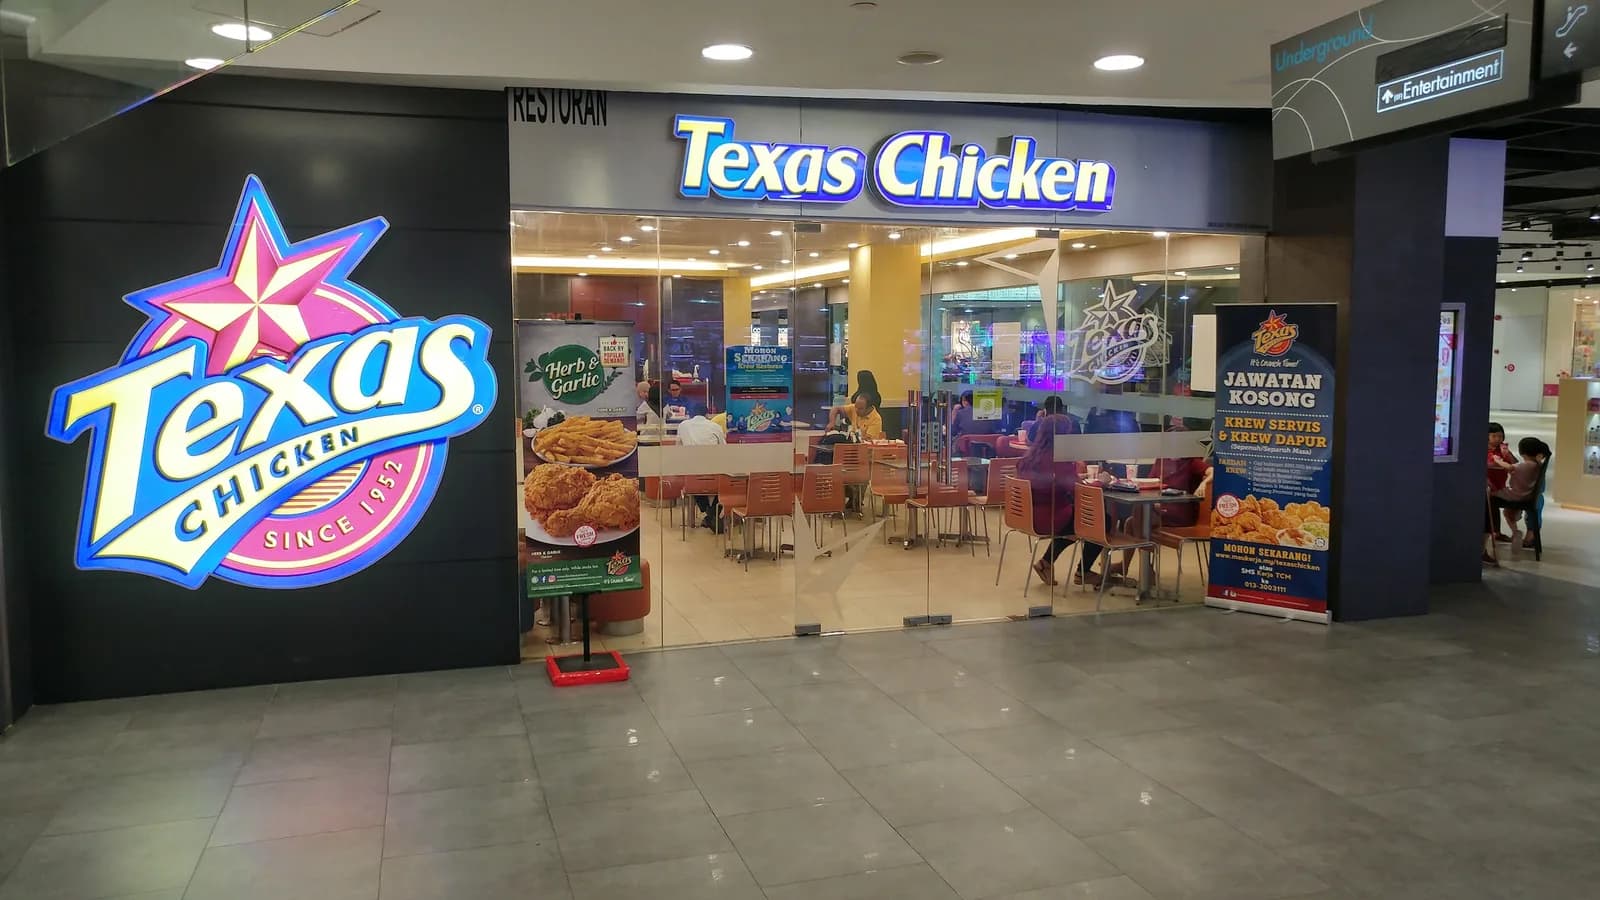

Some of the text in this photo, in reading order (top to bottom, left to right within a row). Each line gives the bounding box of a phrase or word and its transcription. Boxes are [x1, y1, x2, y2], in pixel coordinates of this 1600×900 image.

[1275, 15, 1374, 72] Underground
[1403, 59, 1499, 100] Entertainment
[513, 88, 607, 126] RESTORAN
[677, 119, 1110, 202] Texas Chicken
[1254, 325, 1297, 350] Texas
[545, 356, 600, 379] Herb &
[551, 372, 600, 399] Garlic
[1224, 372, 1322, 389] JAWATAN
[1229, 390, 1316, 408] KOSONG
[65, 324, 475, 544] Texas
[1225, 417, 1321, 433] KREW SERVIS
[1218, 431, 1328, 448] & KREW DAPUR
[1292, 447, 1312, 456] Masa)
[176, 426, 360, 542] CHICKEN
[264, 459, 403, 549] SINCE 1952
[1224, 544, 1312, 562] MOHON SEKARANG!
[1241, 568, 1255, 576] SMS
[1276, 572, 1292, 580] TCM
